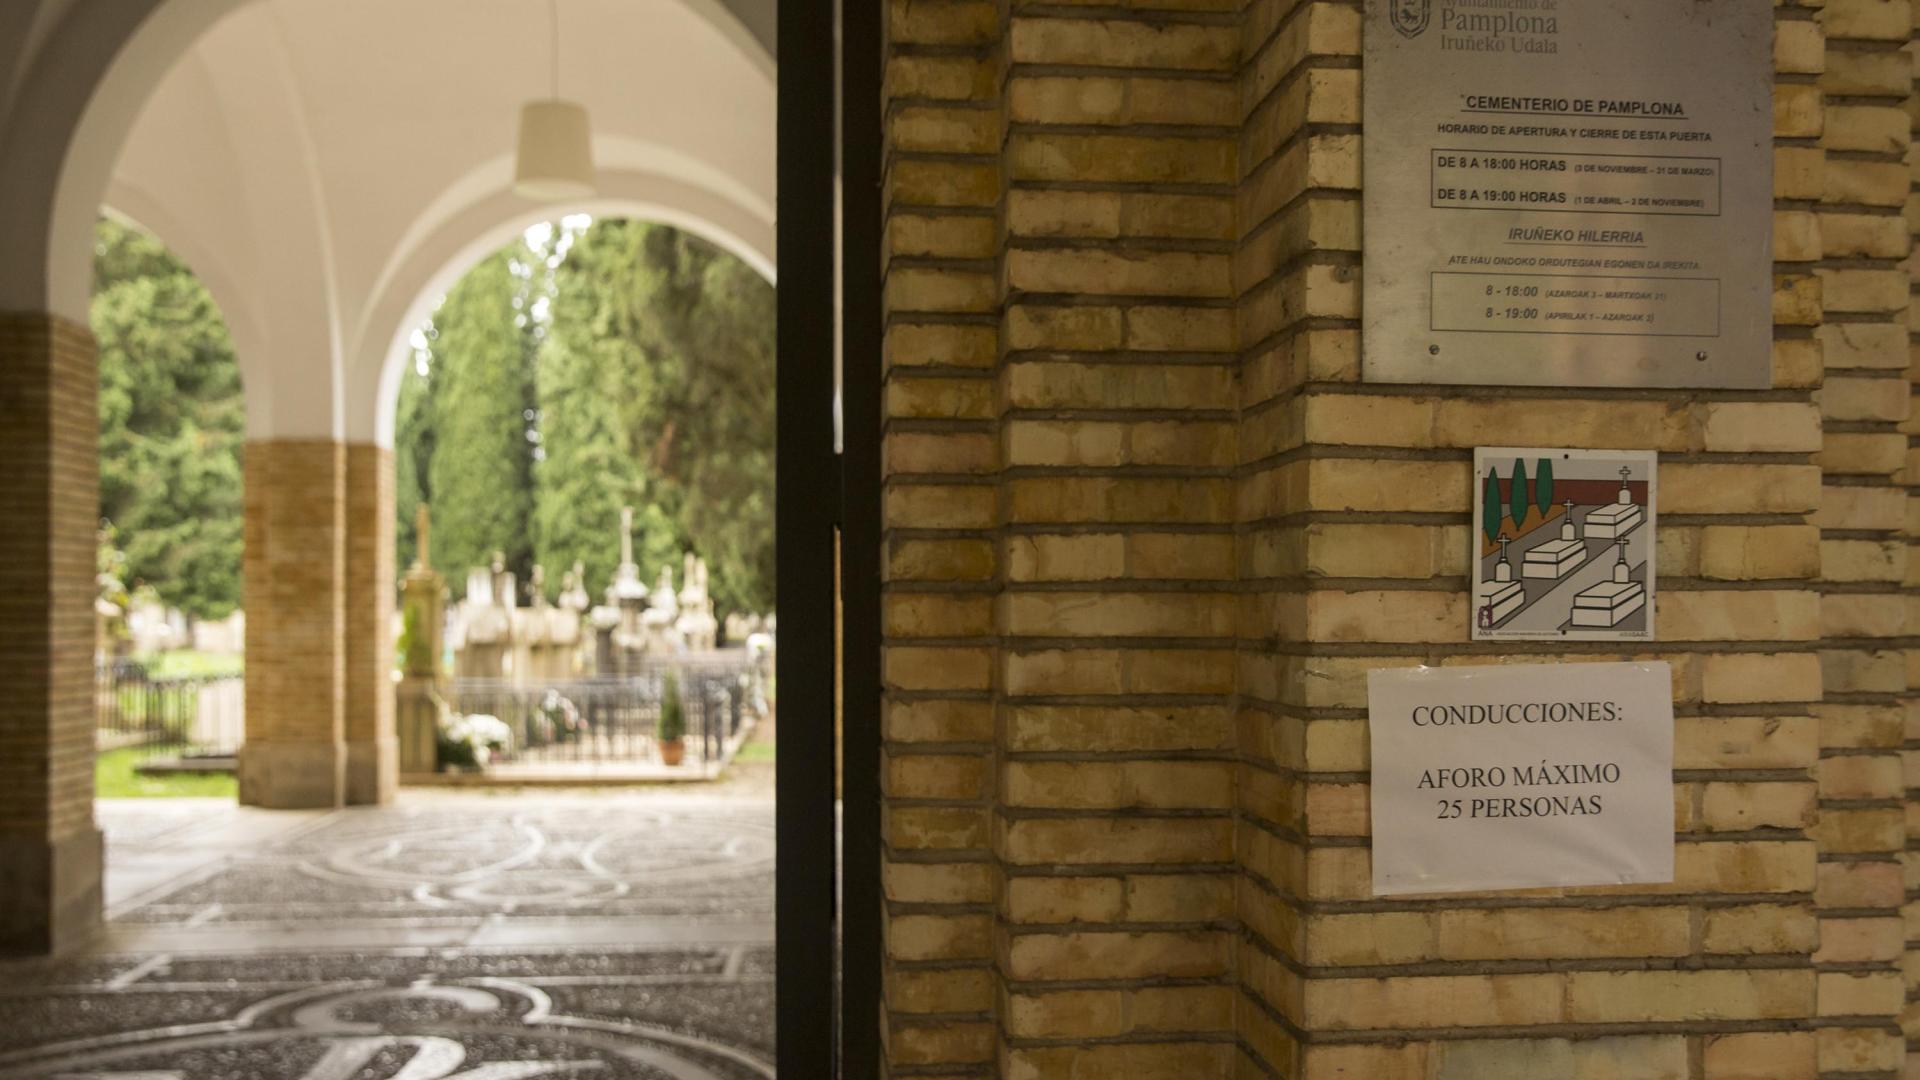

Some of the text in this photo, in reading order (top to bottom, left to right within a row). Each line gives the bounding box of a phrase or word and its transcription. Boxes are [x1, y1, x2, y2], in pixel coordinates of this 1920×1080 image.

[1441, 8, 1558, 38] Pamplona
[1440, 34, 1558, 54] Iruñeko Udala
[1466, 96, 1684, 115] CEMENTERIO DE PAMPLONA
[1437, 124, 1712, 142] HORARIO DE APERTURA Y CIERRE DE ESTA PUERTA
[1438, 156, 1456, 168] DE
[1459, 157, 1467, 168] 8
[1470, 157, 1479, 168] A
[1483, 158, 1516, 170] 18:00
[1519, 160, 1567, 171] HORAS
[1584, 165, 1595, 173] DE
[1598, 165, 1648, 174] NOVIEMBRE
[1667, 167, 1679, 175] DE
[1438, 189, 1456, 199] DE
[1459, 189, 1467, 200] 8
[1470, 190, 1479, 200] A
[1483, 190, 1516, 201] 19:00
[1519, 192, 1567, 203] HORAS
[1597, 197, 1622, 205] ABRIL
[1508, 226, 1644, 243] IRUÑEKO HILERRIA
[1448, 255, 1468, 265] ATE
[1470, 256, 1492, 265] HAU
[1493, 257, 1536, 266] ONDOKO
[1538, 258, 1601, 268] ORDUTEGIAN
[1603, 260, 1645, 269] EGONEN
[1486, 285, 1493, 296] 8
[1505, 286, 1538, 297] 18:00
[1486, 307, 1493, 318] 8
[1505, 308, 1538, 319] 19:00
[1412, 701, 1623, 726] CONDUCCIONES:
[1417, 760, 1621, 789] AFORO MÁXIMO
[1437, 795, 1602, 819] 25 PERSONAS
